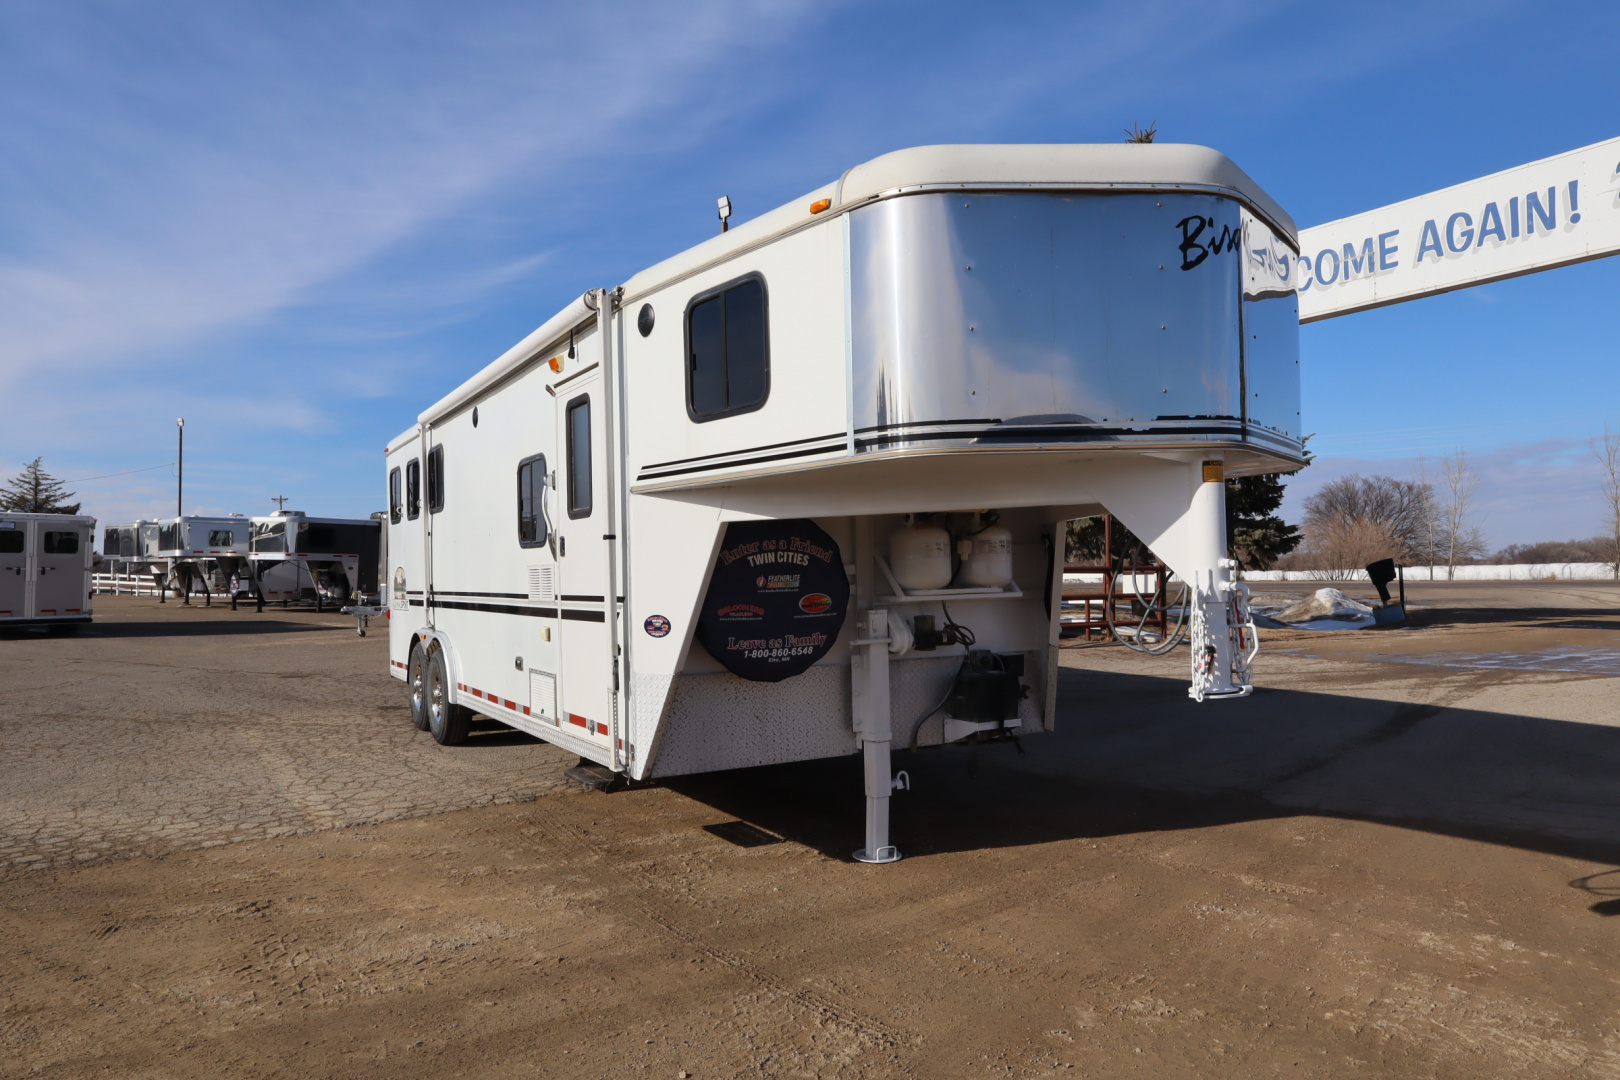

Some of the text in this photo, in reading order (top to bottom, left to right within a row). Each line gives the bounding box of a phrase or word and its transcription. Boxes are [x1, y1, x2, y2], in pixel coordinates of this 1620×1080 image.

[1416, 180, 1581, 263] AGAIN!
[719, 536, 833, 566] Enter as a Friend
[747, 551, 810, 567] TWIN CITIES
[768, 574, 801, 583] FEATHERLITE
[727, 631, 828, 650] Leave as Family
[744, 646, 814, 659] 1-800-860-6548
